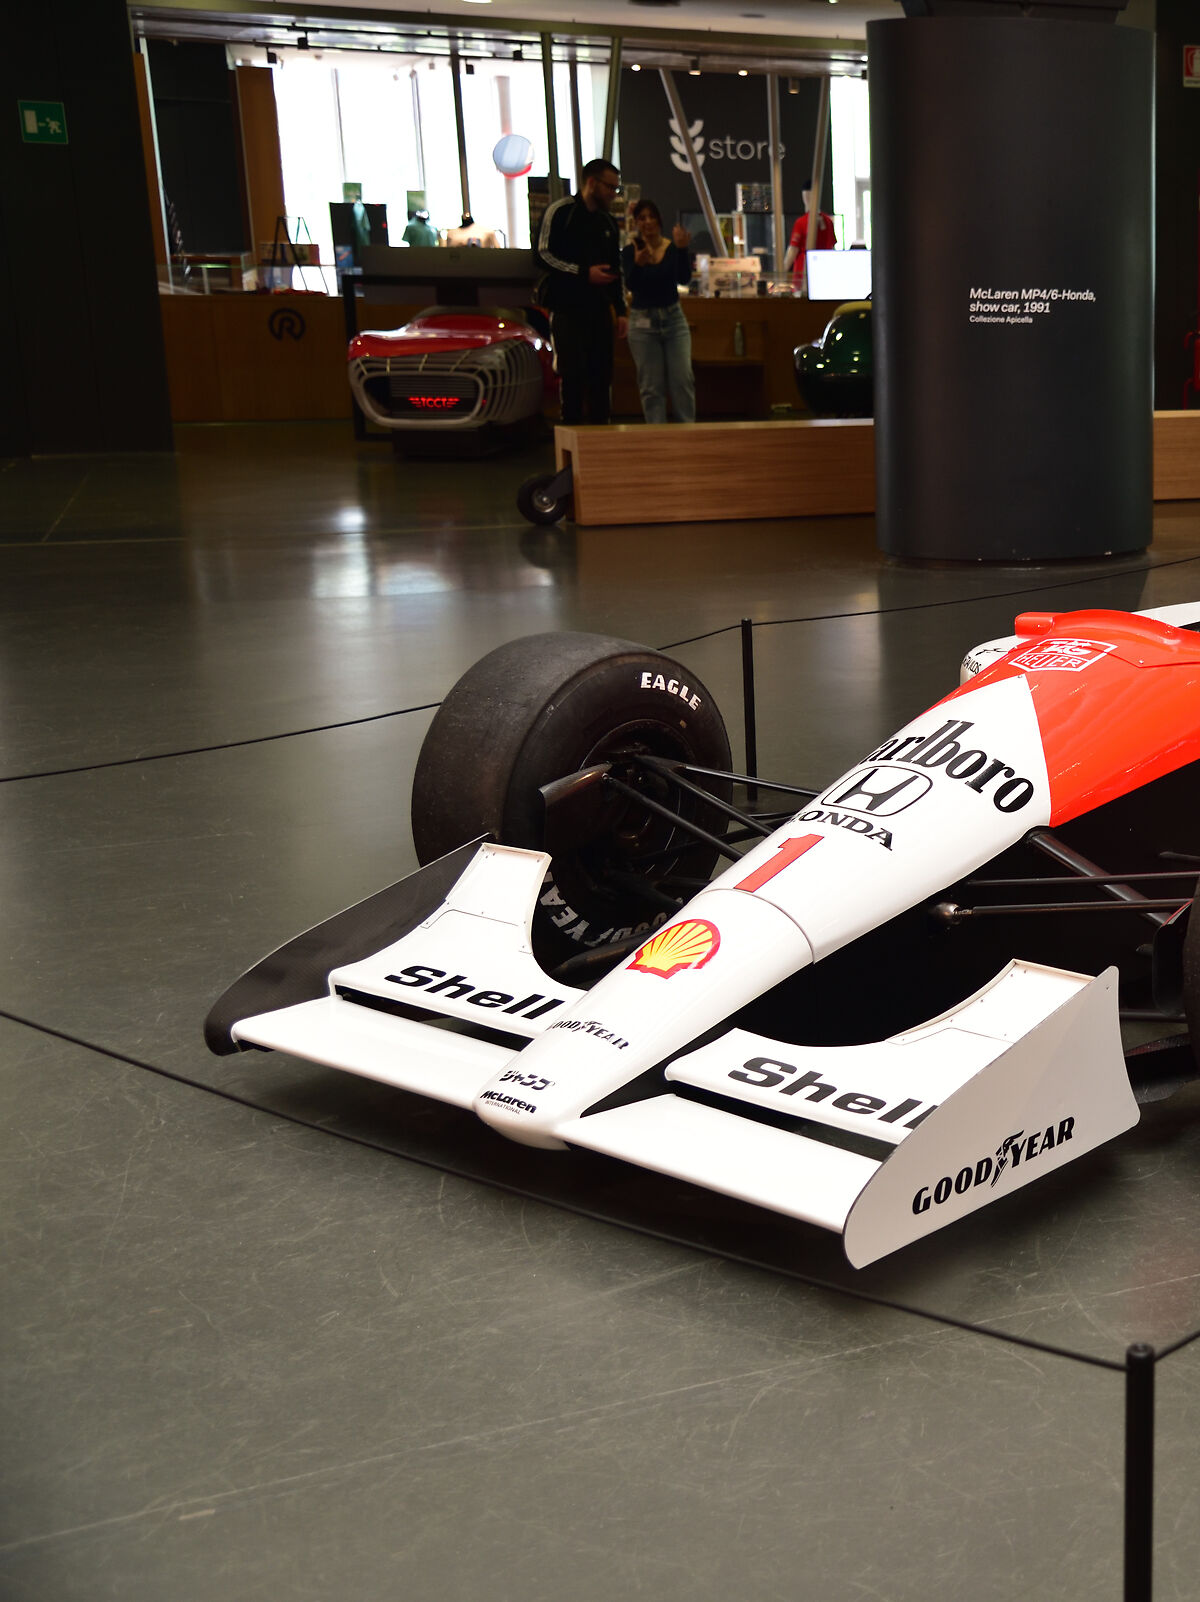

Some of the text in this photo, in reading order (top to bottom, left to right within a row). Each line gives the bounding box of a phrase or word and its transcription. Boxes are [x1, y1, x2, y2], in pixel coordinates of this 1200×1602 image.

[969, 288, 1096, 302] McLaren MP4/6-Honda,
[969, 301, 1051, 314] show car, 1991
[969, 315, 1033, 324] Collezione Apicella
[1016, 653, 1081, 669] HEUER
[641, 672, 702, 711] EAGLE
[861, 719, 1034, 813] arlboro
[790, 810, 893, 852] ONDA
[733, 834, 825, 893] 1
[384, 965, 566, 1021] Shell
[551, 1020, 629, 1050] OODYEAR
[480, 1090, 537, 1114] McLaren
[484, 1100, 521, 1115] INTERNATIONAL
[727, 1056, 940, 1130] Shell
[911, 1116, 1075, 1215] GOODYEAR
